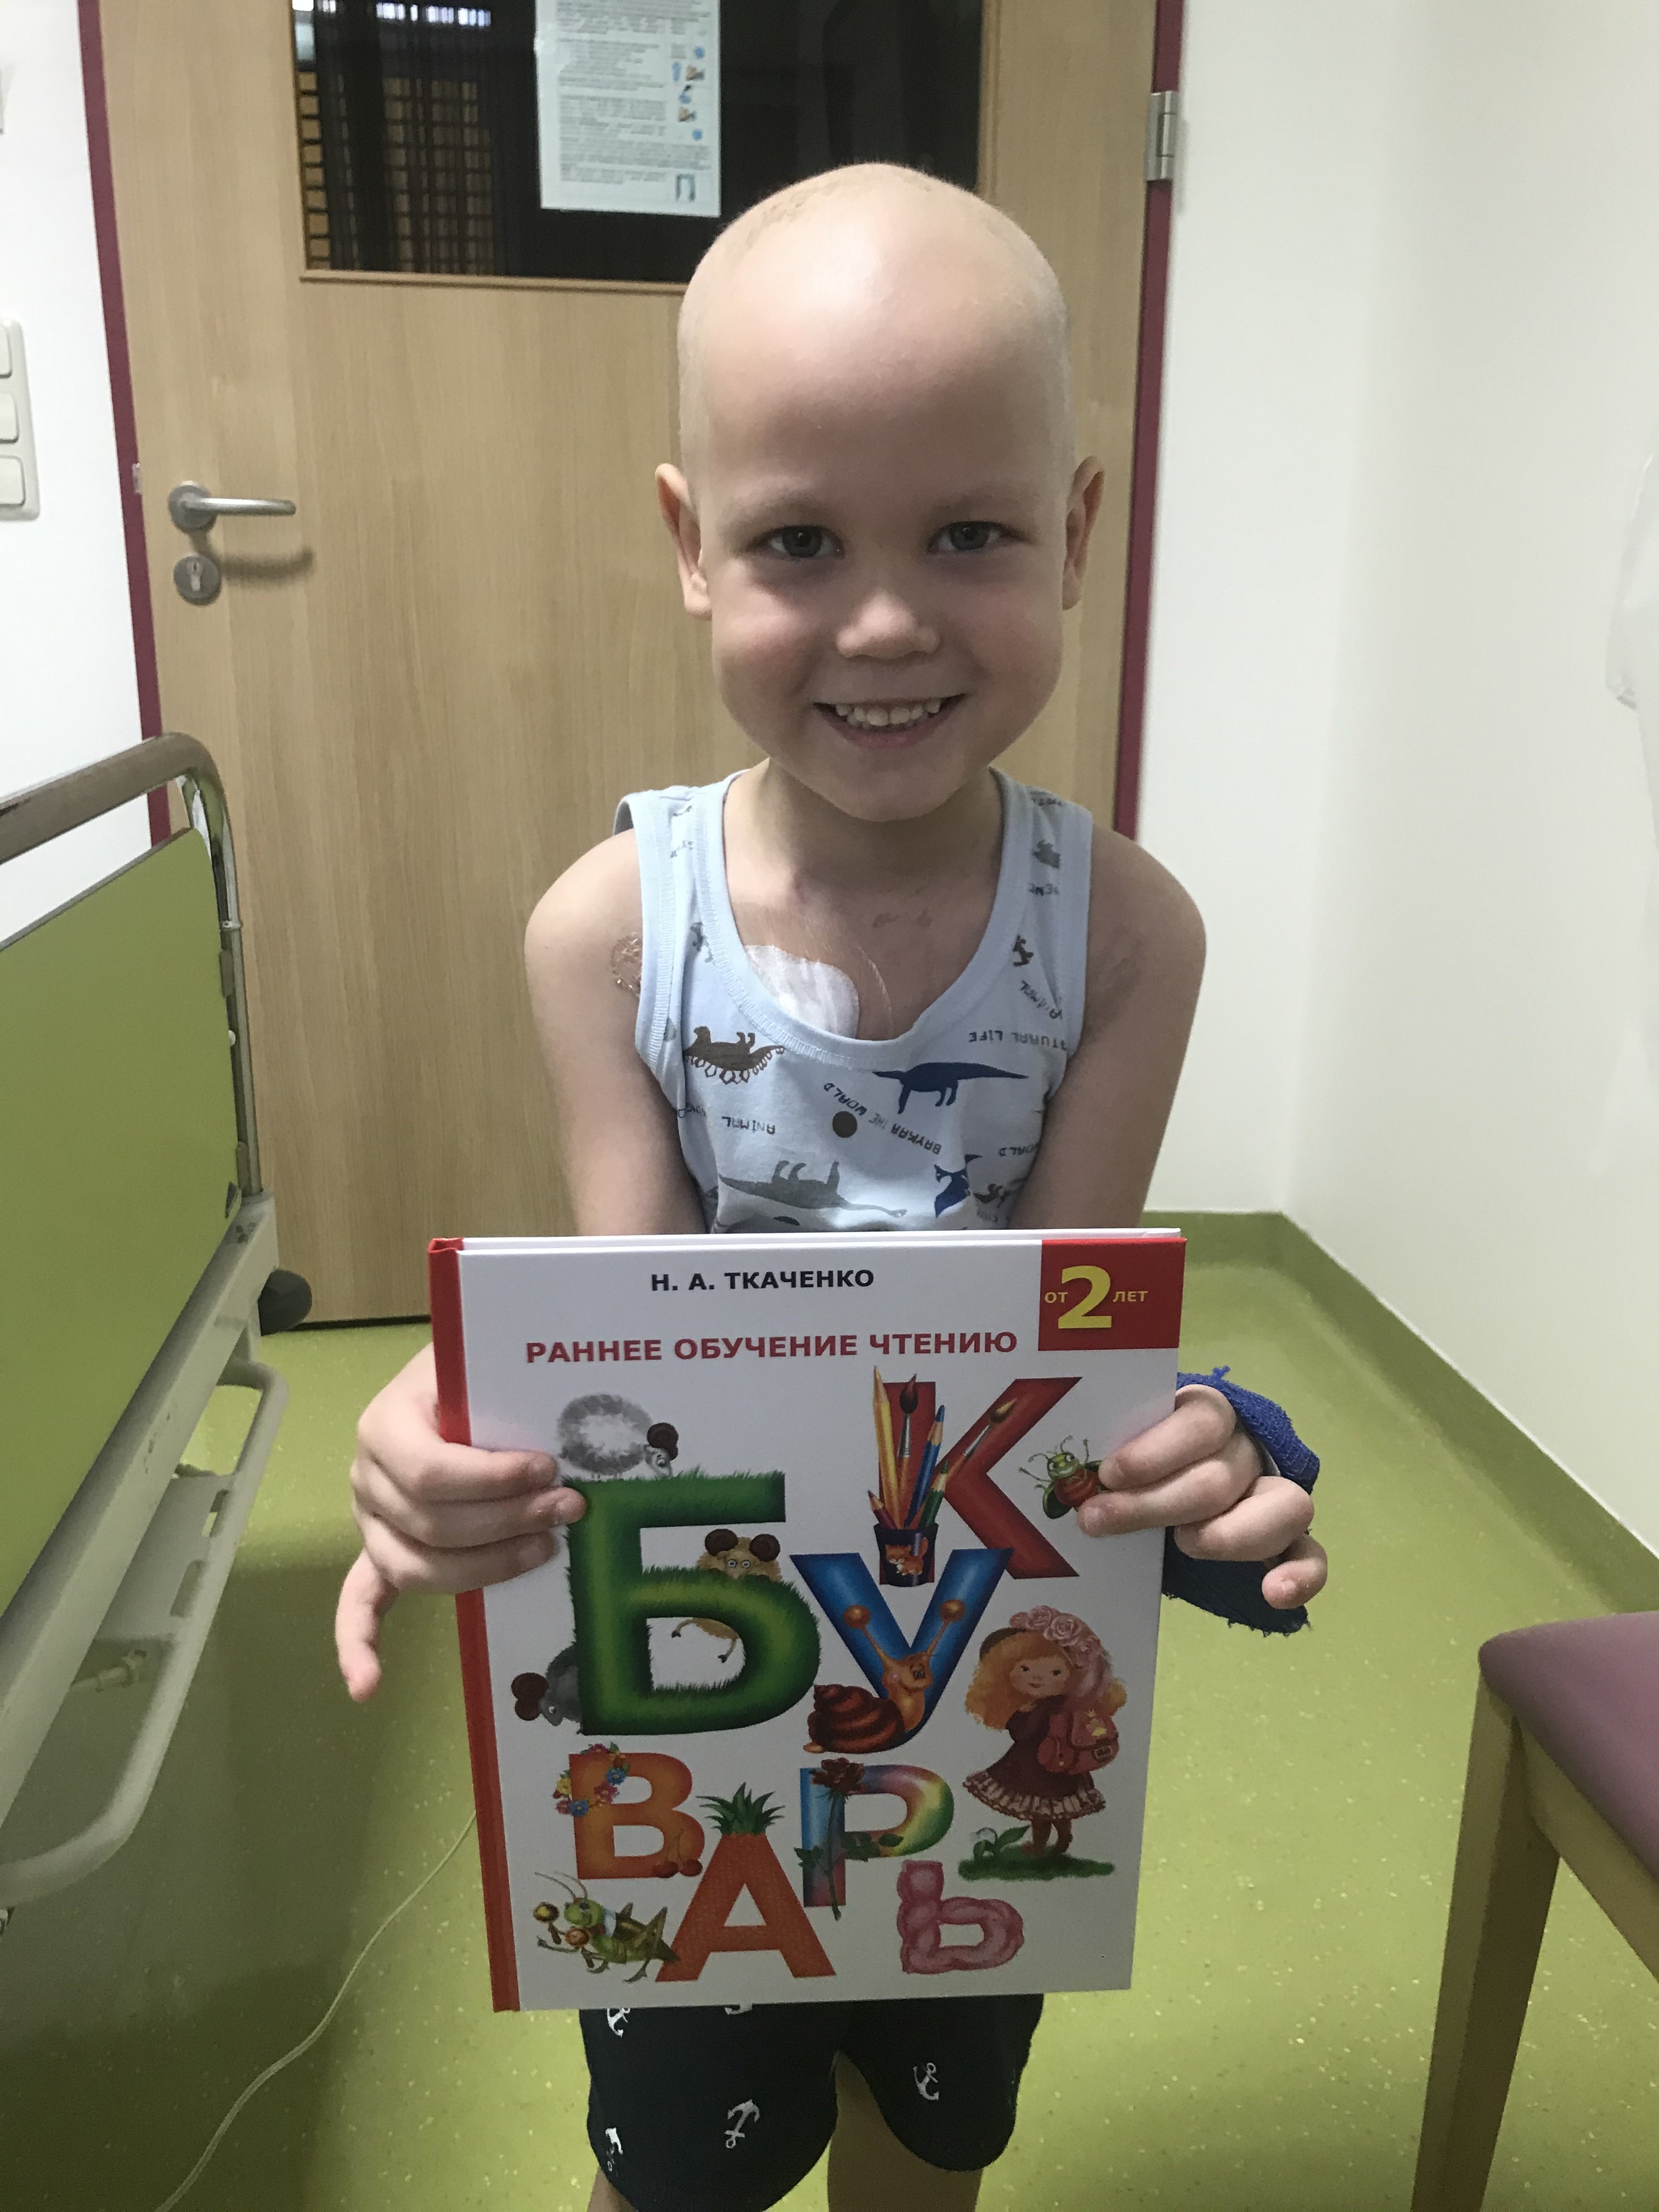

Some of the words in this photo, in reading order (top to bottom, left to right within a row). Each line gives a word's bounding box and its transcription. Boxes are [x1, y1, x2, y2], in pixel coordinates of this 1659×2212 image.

[968, 1030, 1003, 1043] LIFE
[823, 1082, 868, 1117] WORLD
[721, 1116, 776, 1136] ANIMAL
[868, 1113, 889, 1130] THE
[651, 1273, 678, 1291] Н.
[688, 1273, 715, 1291] А.
[724, 1269, 874, 1290] ТКАЧЕНКО
[1044, 1291, 1069, 1304] ОТ
[1058, 1265, 1112, 1329] 2
[1112, 1290, 1149, 1302] ЛЕТ
[525, 1339, 663, 1364] РАННЕЕ
[673, 1334, 859, 1361] ОБУЧЕНИЕ
[869, 1330, 1018, 1356] ЧТЕНИЮ
